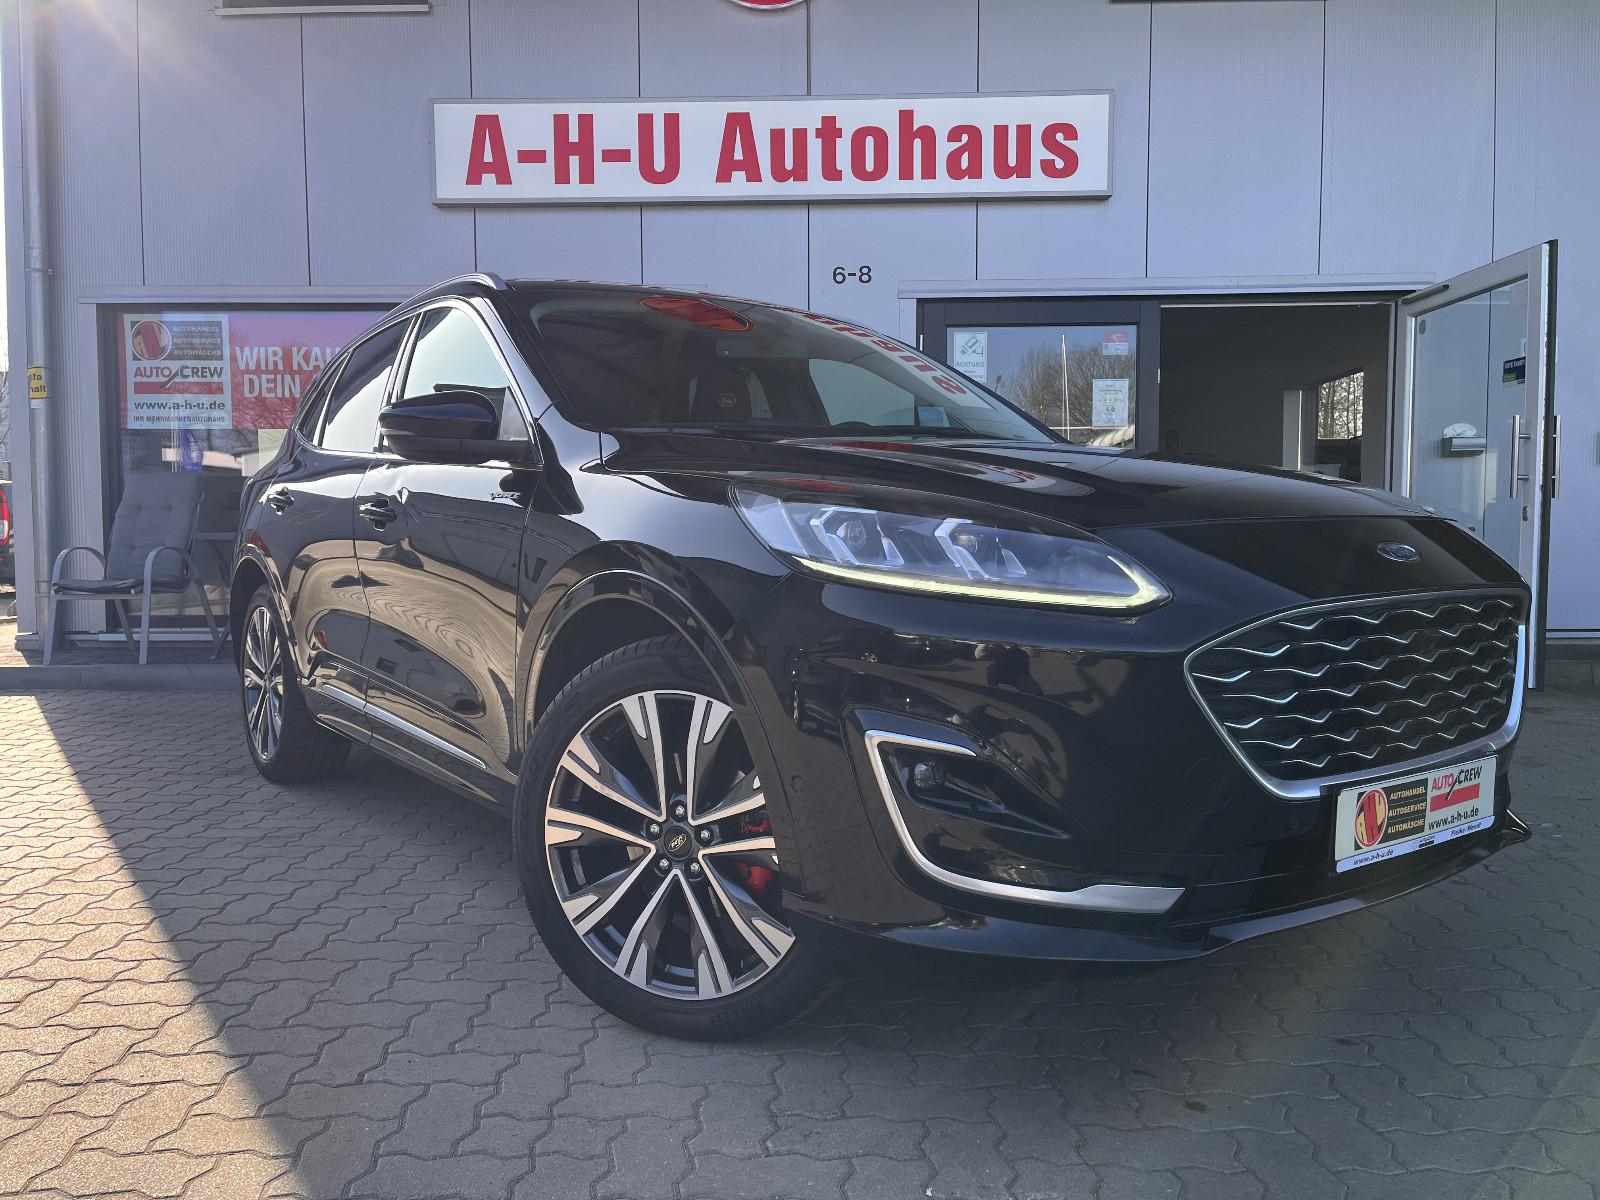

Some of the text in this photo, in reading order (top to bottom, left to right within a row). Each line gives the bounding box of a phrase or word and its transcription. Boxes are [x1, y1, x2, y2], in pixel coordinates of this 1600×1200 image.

[466, 109, 1079, 185] A-H-U Autohaus
[833, 265, 872, 284] 6-8
[235, 346, 284, 370] WIR
[243, 374, 300, 398] DEIN
[134, 400, 226, 410] www.a-h-u.de
[1390, 786, 1426, 800] AUTOHANDEL
[1388, 802, 1427, 817] AUTOSERVICE
[1428, 805, 1480, 831] www.a-h-u.de
